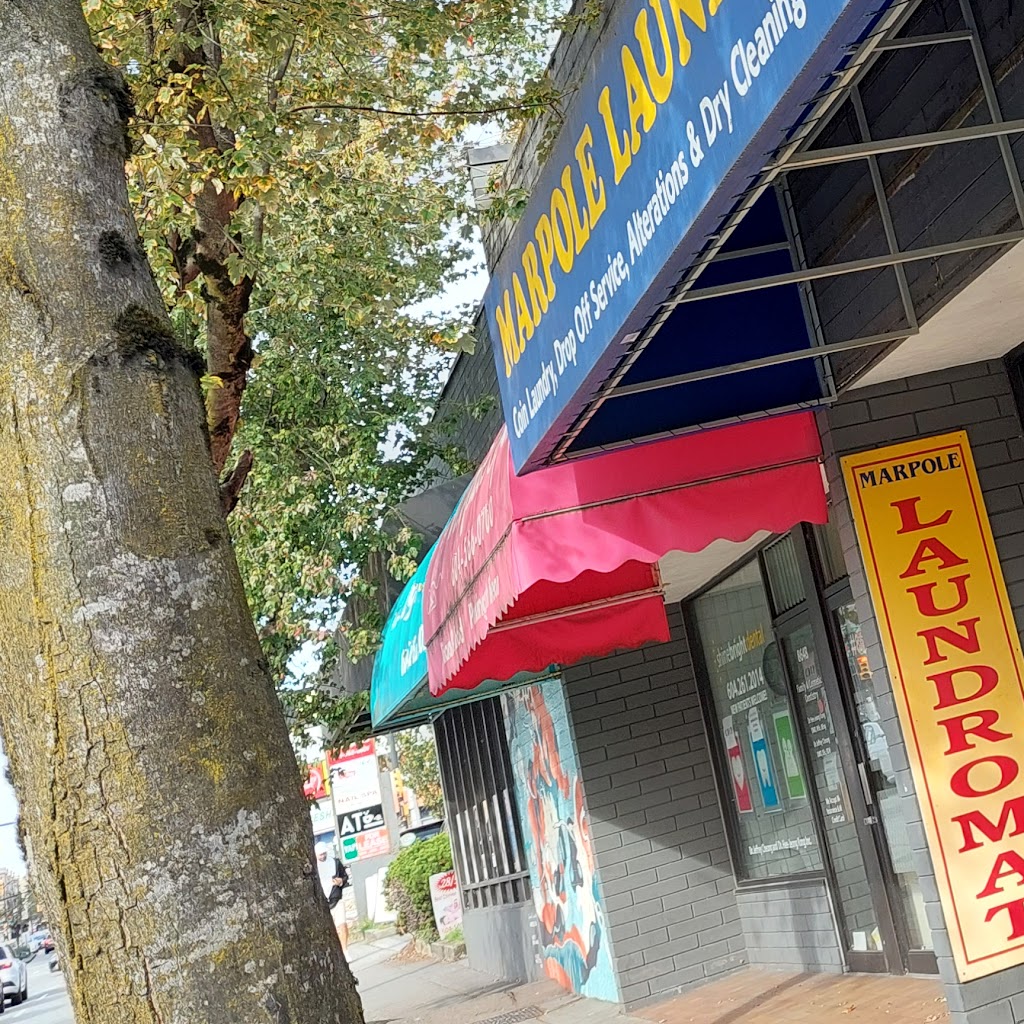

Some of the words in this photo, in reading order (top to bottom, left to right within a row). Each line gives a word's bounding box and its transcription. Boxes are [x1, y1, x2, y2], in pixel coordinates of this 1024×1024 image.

[495, 124, 606, 378] MARPOLE
[512, 400, 528, 439] Coin
[525, 360, 559, 418] Laundry,
[553, 330, 577, 375] Drop
[574, 302, 592, 344] Off
[589, 247, 631, 320] Service,
[625, 151, 690, 265] Alterations
[686, 120, 704, 168] &
[699, 80, 734, 148] Dry
[859, 453, 962, 489] MARPOLE
